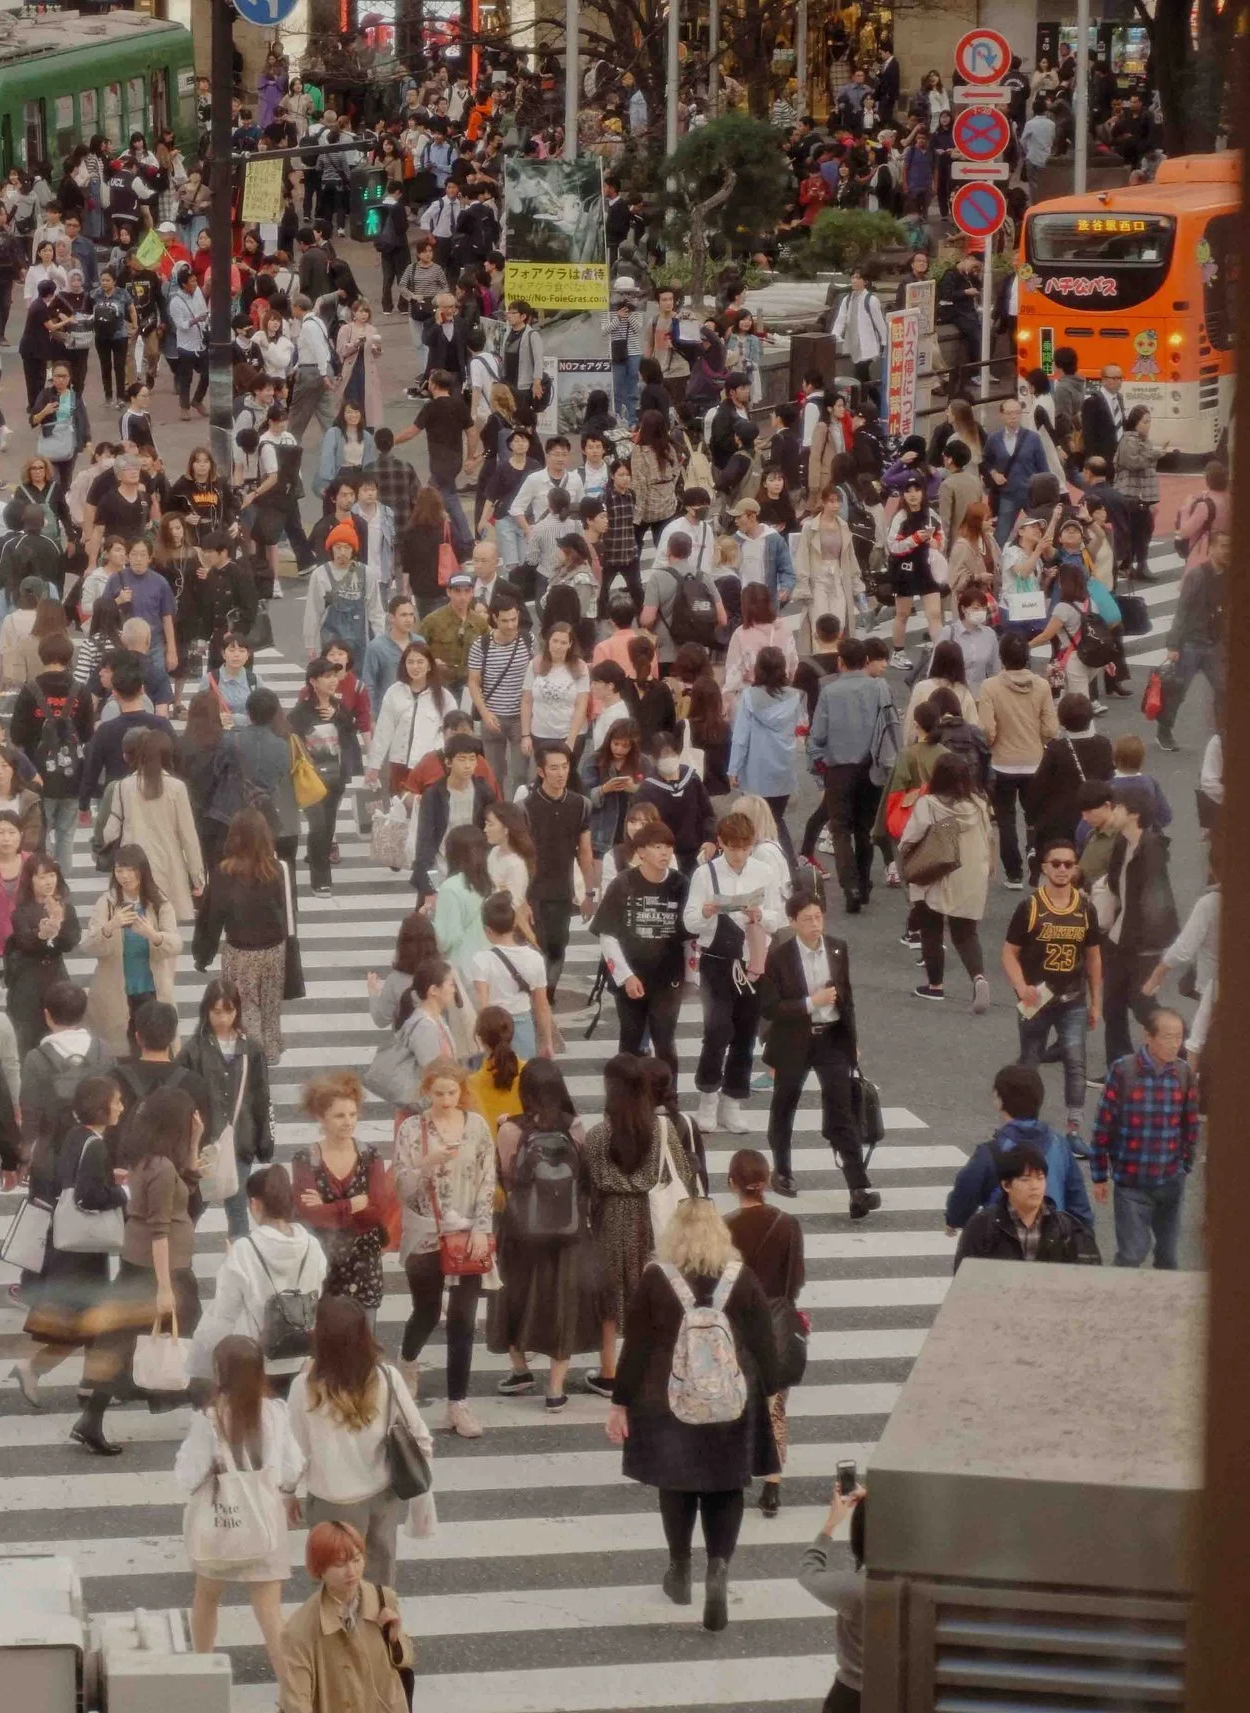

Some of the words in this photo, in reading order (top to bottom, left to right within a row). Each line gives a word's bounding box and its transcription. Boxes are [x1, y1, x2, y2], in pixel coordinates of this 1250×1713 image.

[1077, 219, 1146, 232] 渋谷駅西口
[508, 267, 606, 281] フォアグラは虐待
[1045, 276, 1118, 296] ハチ公バス
[1043, 943, 1076, 971] 23
